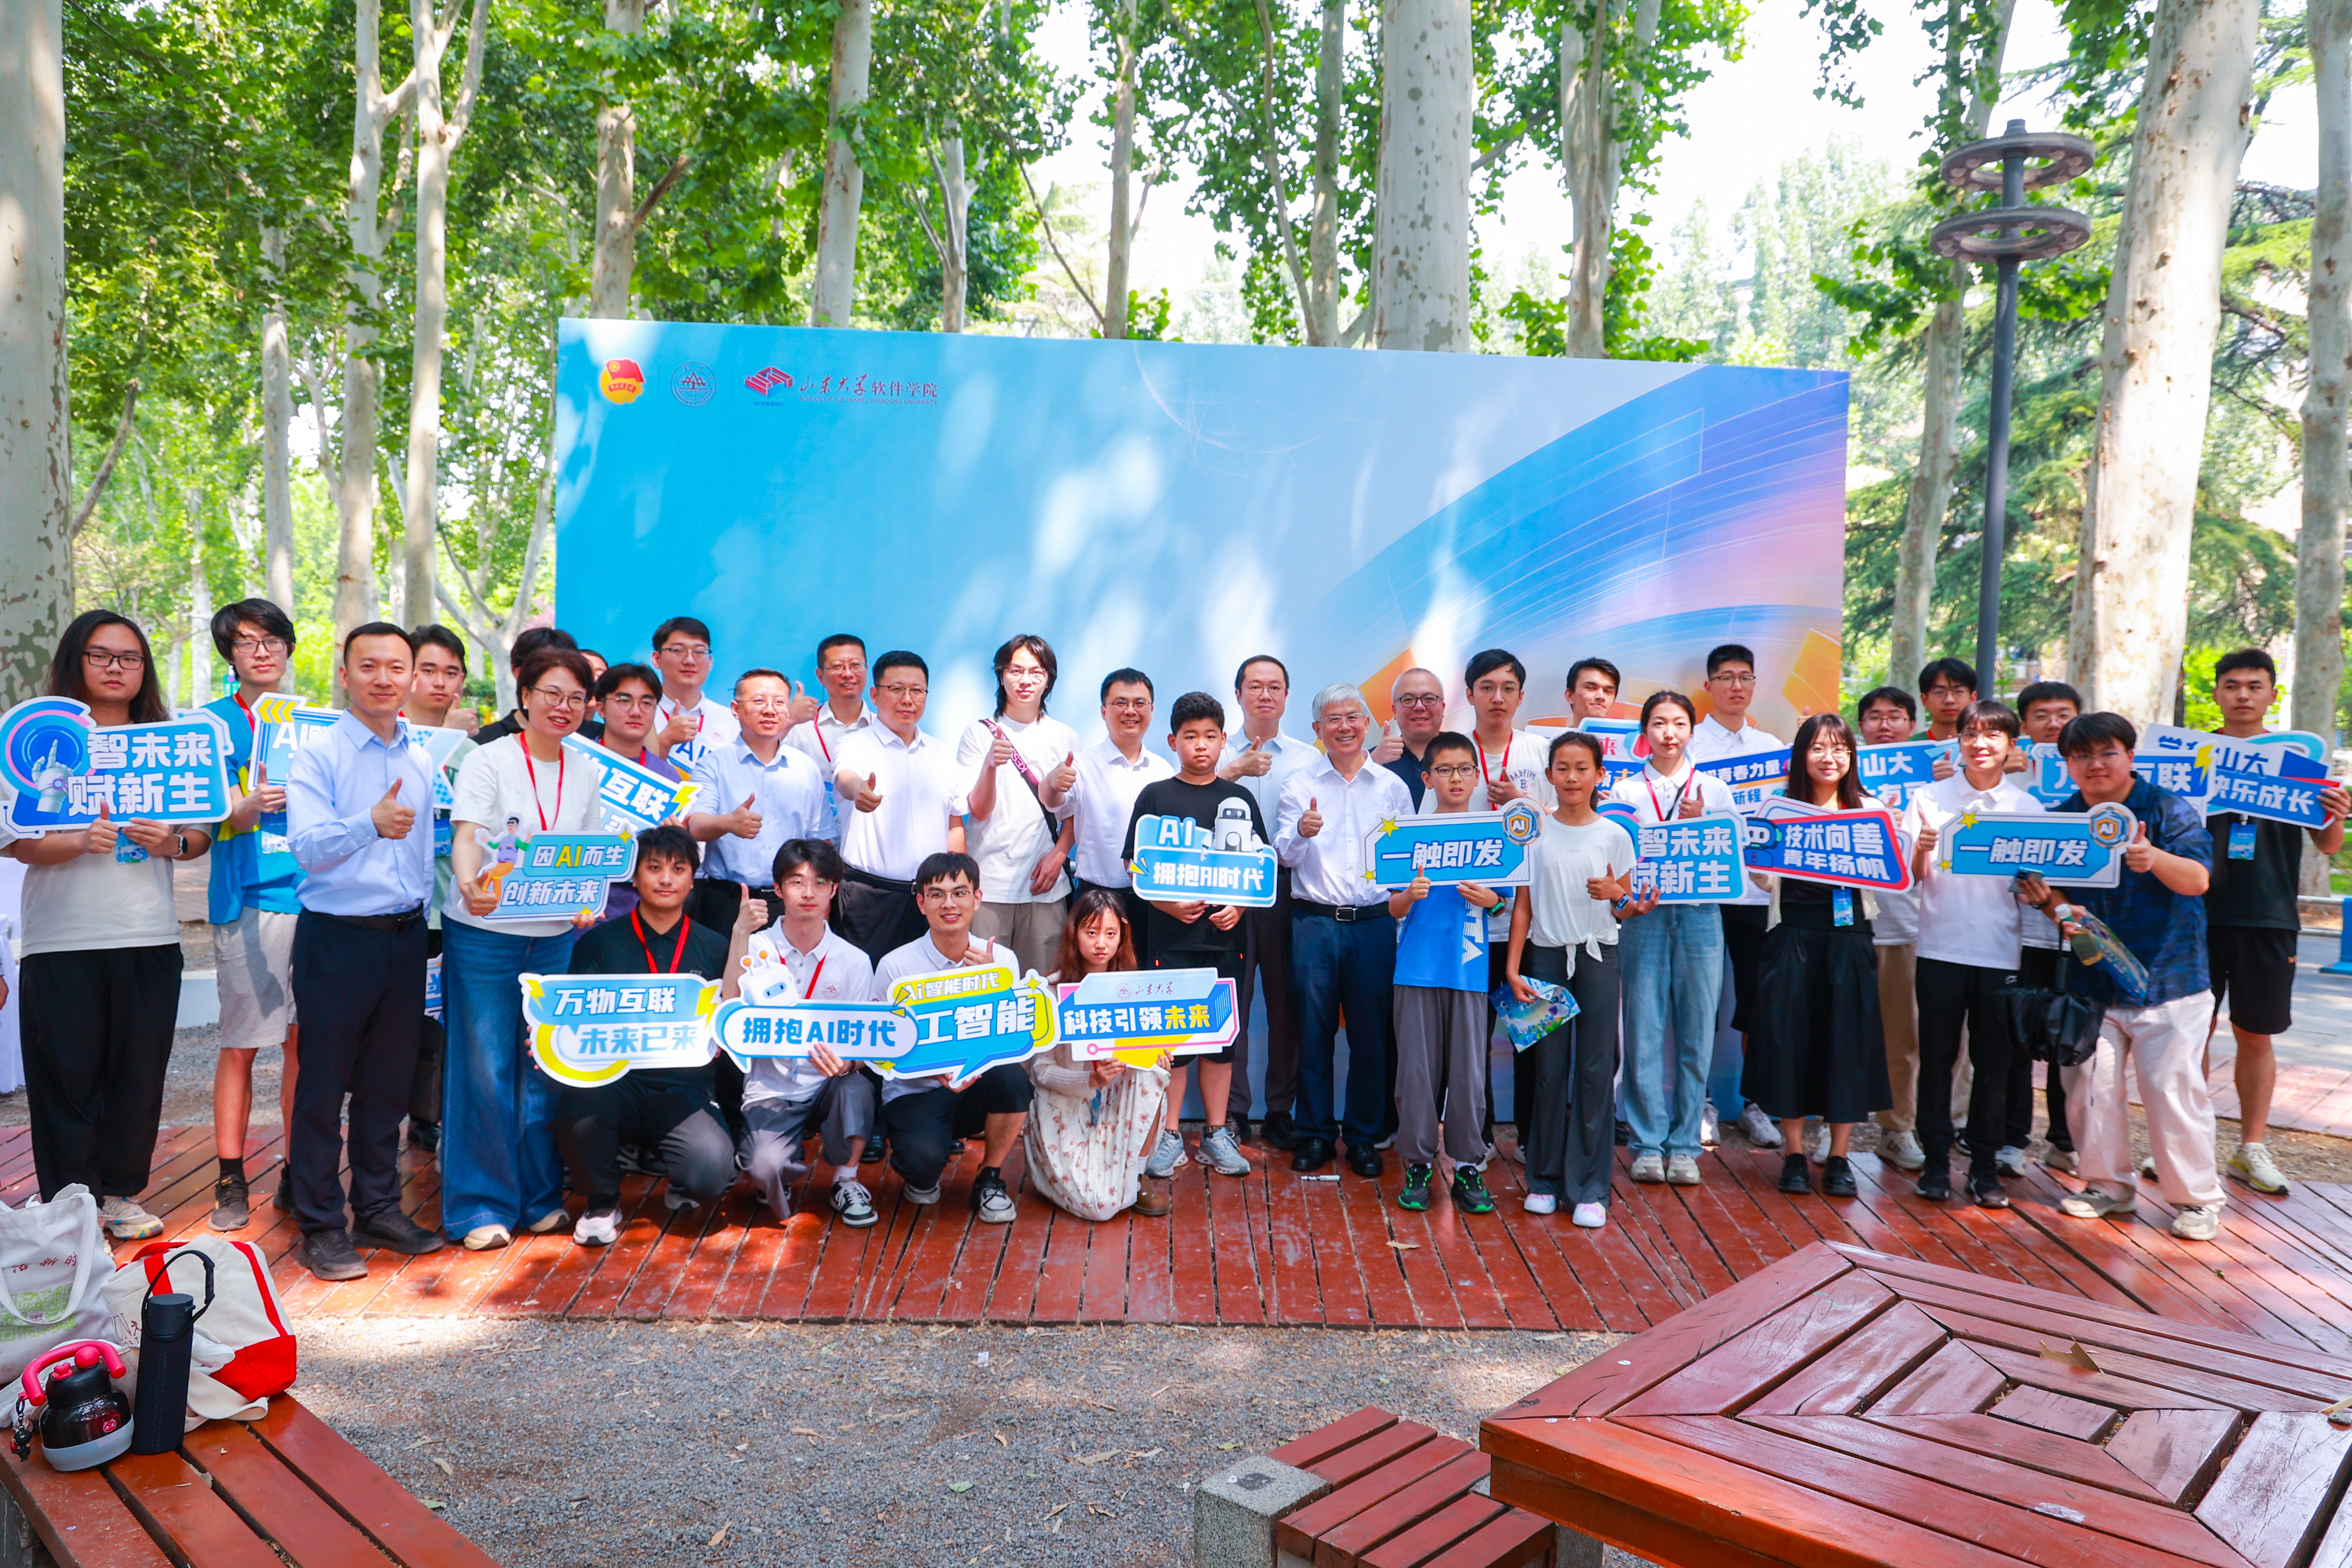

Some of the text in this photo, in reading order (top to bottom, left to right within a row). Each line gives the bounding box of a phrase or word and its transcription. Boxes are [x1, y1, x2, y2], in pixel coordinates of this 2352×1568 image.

[86, 732, 213, 769] 智未来
[1857, 751, 1914, 777] 山大
[67, 772, 212, 817] 赋新生
[1158, 818, 1193, 846] AI
[1512, 820, 1525, 831] AI
[1785, 823, 1884, 856] 技术向善
[2101, 823, 2113, 834] AI
[531, 845, 625, 867] 因AI而生
[1382, 839, 1504, 870] 一触即发
[1638, 826, 1733, 857] 智未来
[1959, 837, 2089, 866] 一触即发
[1152, 861, 1265, 891] 拥抱AI时代
[1631, 860, 1731, 894] 赋新生
[1783, 849, 1891, 881] 青年扬帆
[501, 879, 601, 906] 创新未来
[553, 986, 677, 1016] 万物互联
[1135, 980, 1173, 995] 山东大学
[742, 1016, 897, 1047] 拥抱AI时代
[1063, 1003, 1211, 1035] 科技引领未来
[579, 1026, 698, 1056] 未来已来
